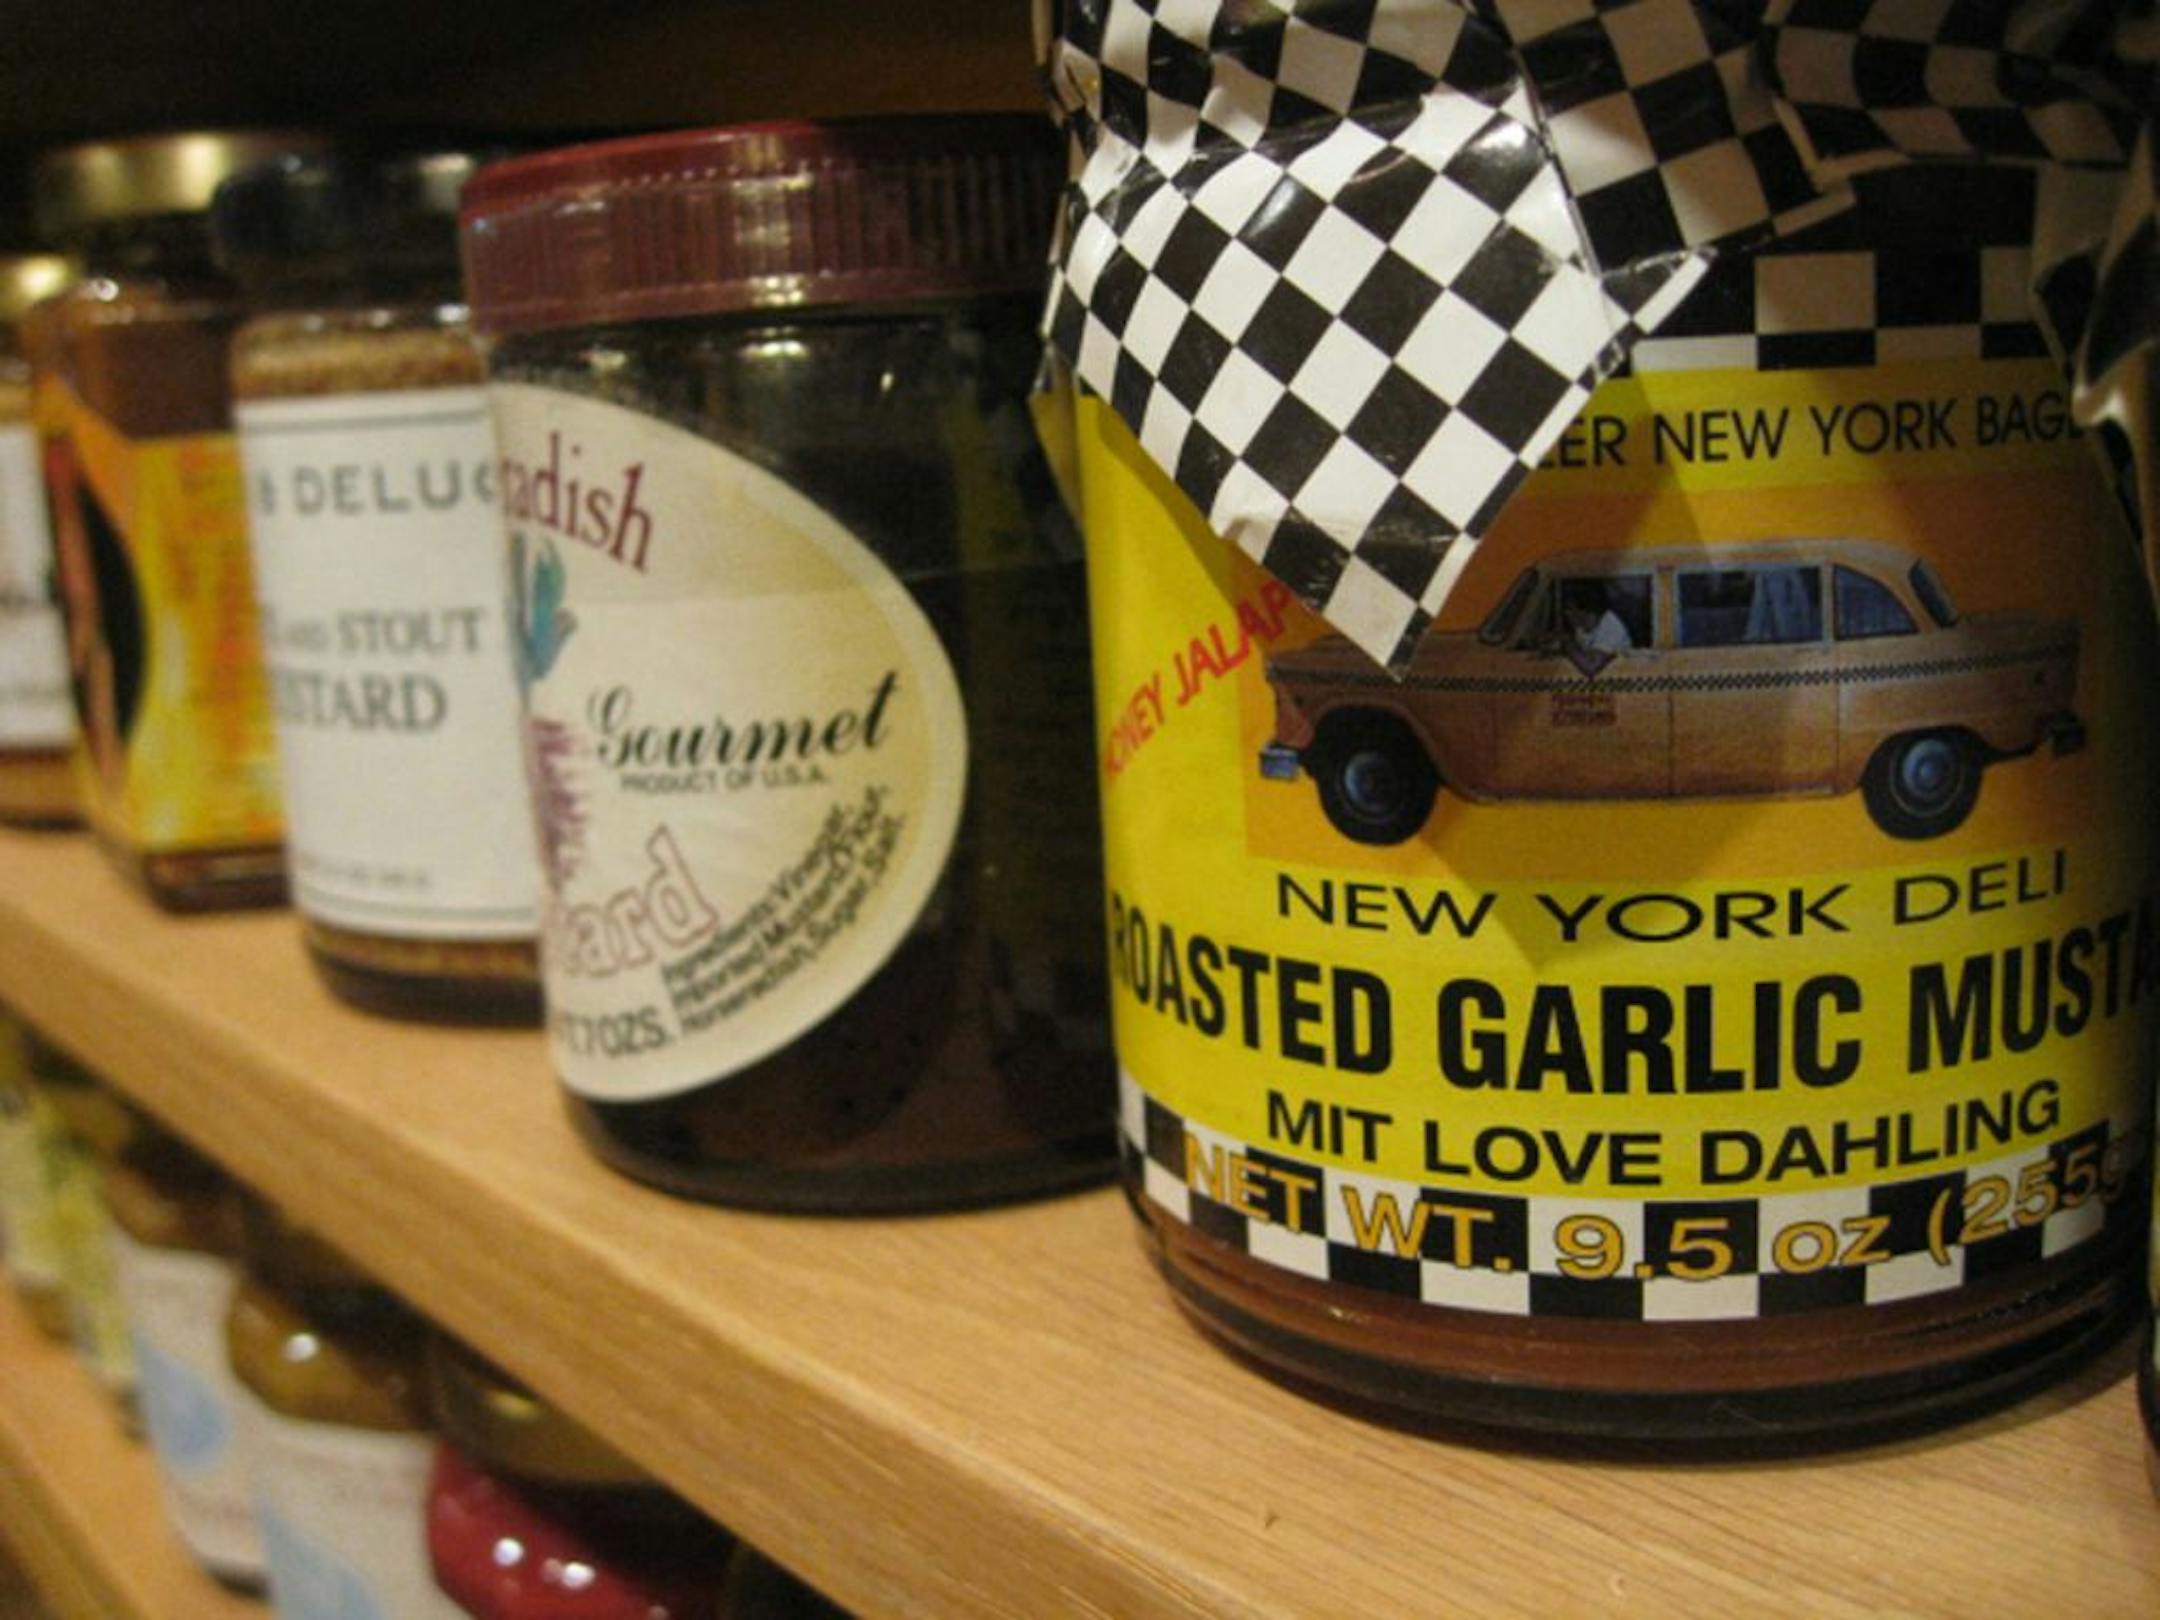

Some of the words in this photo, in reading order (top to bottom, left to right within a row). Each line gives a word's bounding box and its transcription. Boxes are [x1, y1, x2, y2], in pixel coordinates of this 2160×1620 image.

[1652, 408, 1790, 464] NEW
[1808, 398, 1957, 456] YORK
[335, 606, 484, 655] STOUT
[587, 669, 899, 769] Gourmet
[1276, 871, 1497, 938] NEW
[1535, 883, 1850, 943] YORK
[1893, 850, 2066, 926] DELI
[1437, 972, 1861, 1095] GARLIC
[1266, 1089, 1393, 1162] MIT
[1424, 1120, 1662, 1186] LOVE
[1701, 1079, 2060, 1185] DAHLING
[1184, 1131, 1316, 1234] NET
[1340, 1183, 1514, 1272] WT.
[1553, 1213, 1734, 1283] 9.5
